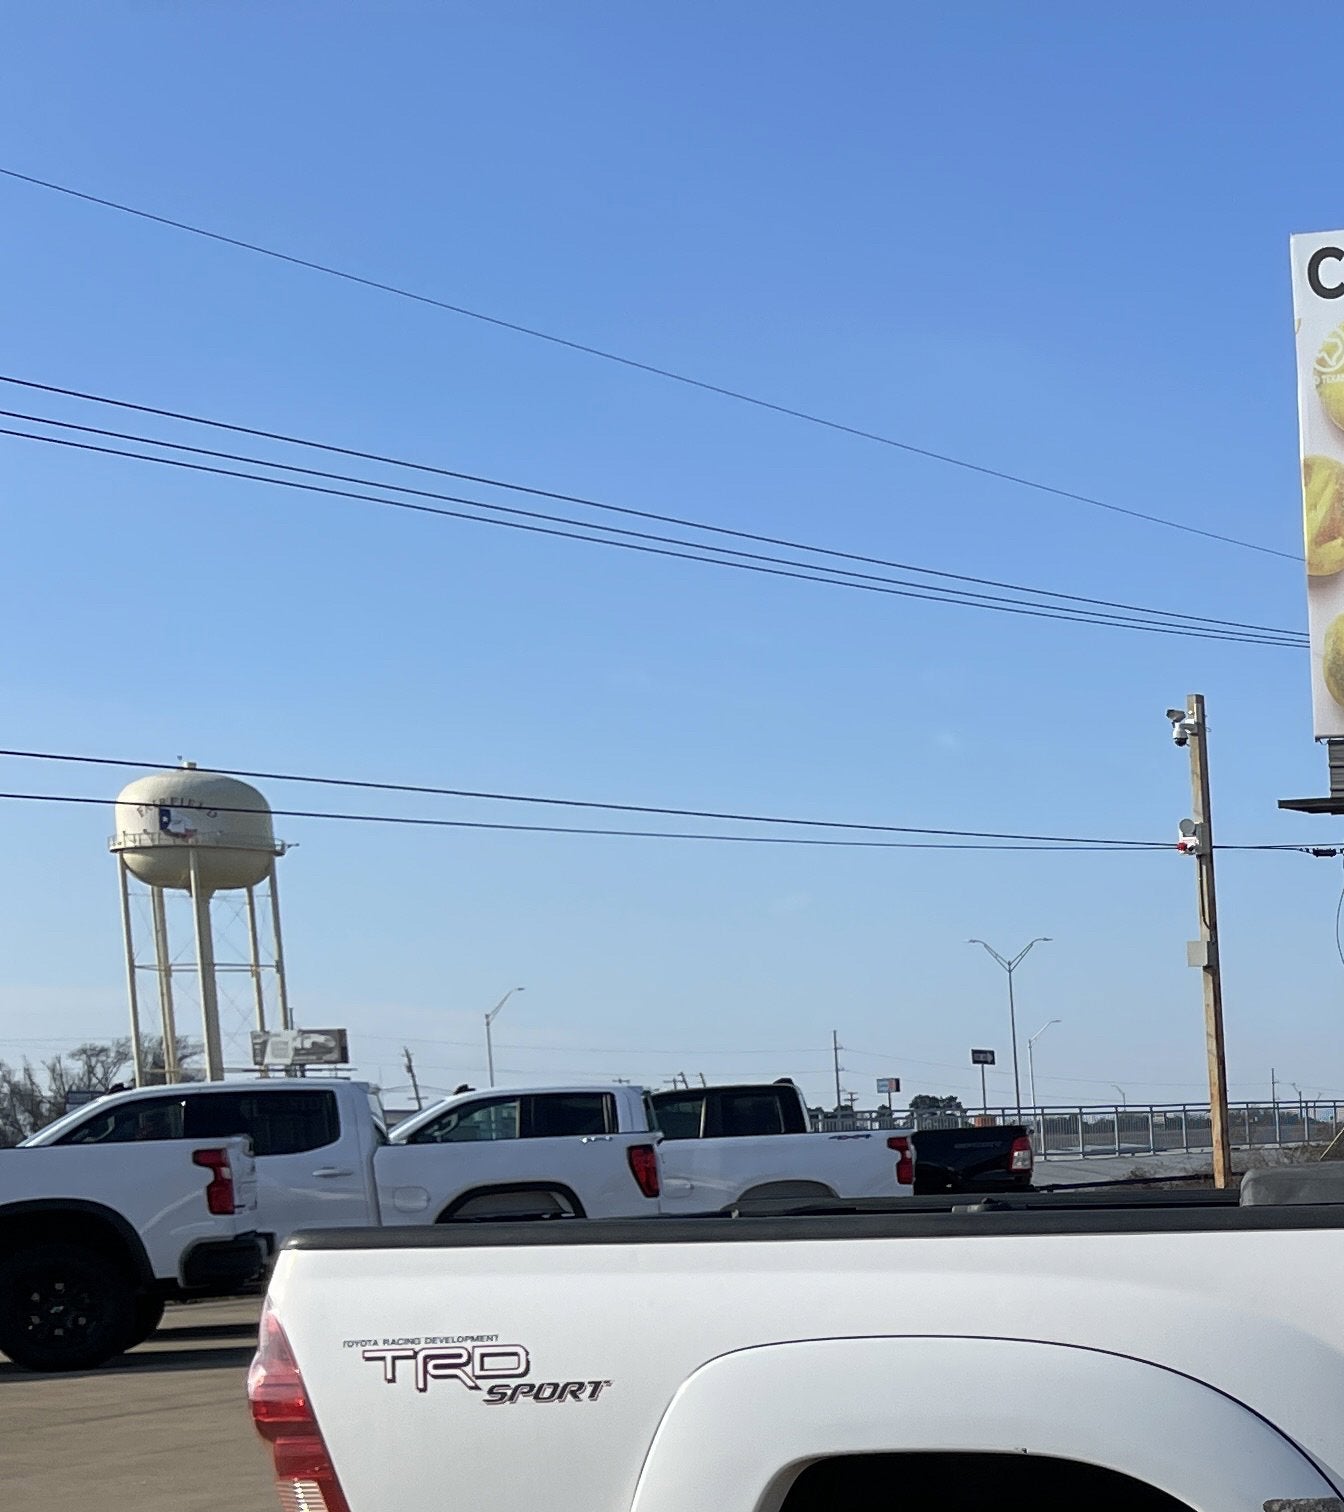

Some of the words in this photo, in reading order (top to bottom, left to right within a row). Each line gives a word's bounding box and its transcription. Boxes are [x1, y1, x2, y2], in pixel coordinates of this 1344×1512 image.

[343, 1339, 378, 1348] TOYOTA
[383, 1338, 420, 1346] RACING
[424, 1335, 498, 1345] DEVELOPMENT
[362, 1344, 530, 1392] TRD
[483, 1380, 607, 1405] SPORT
